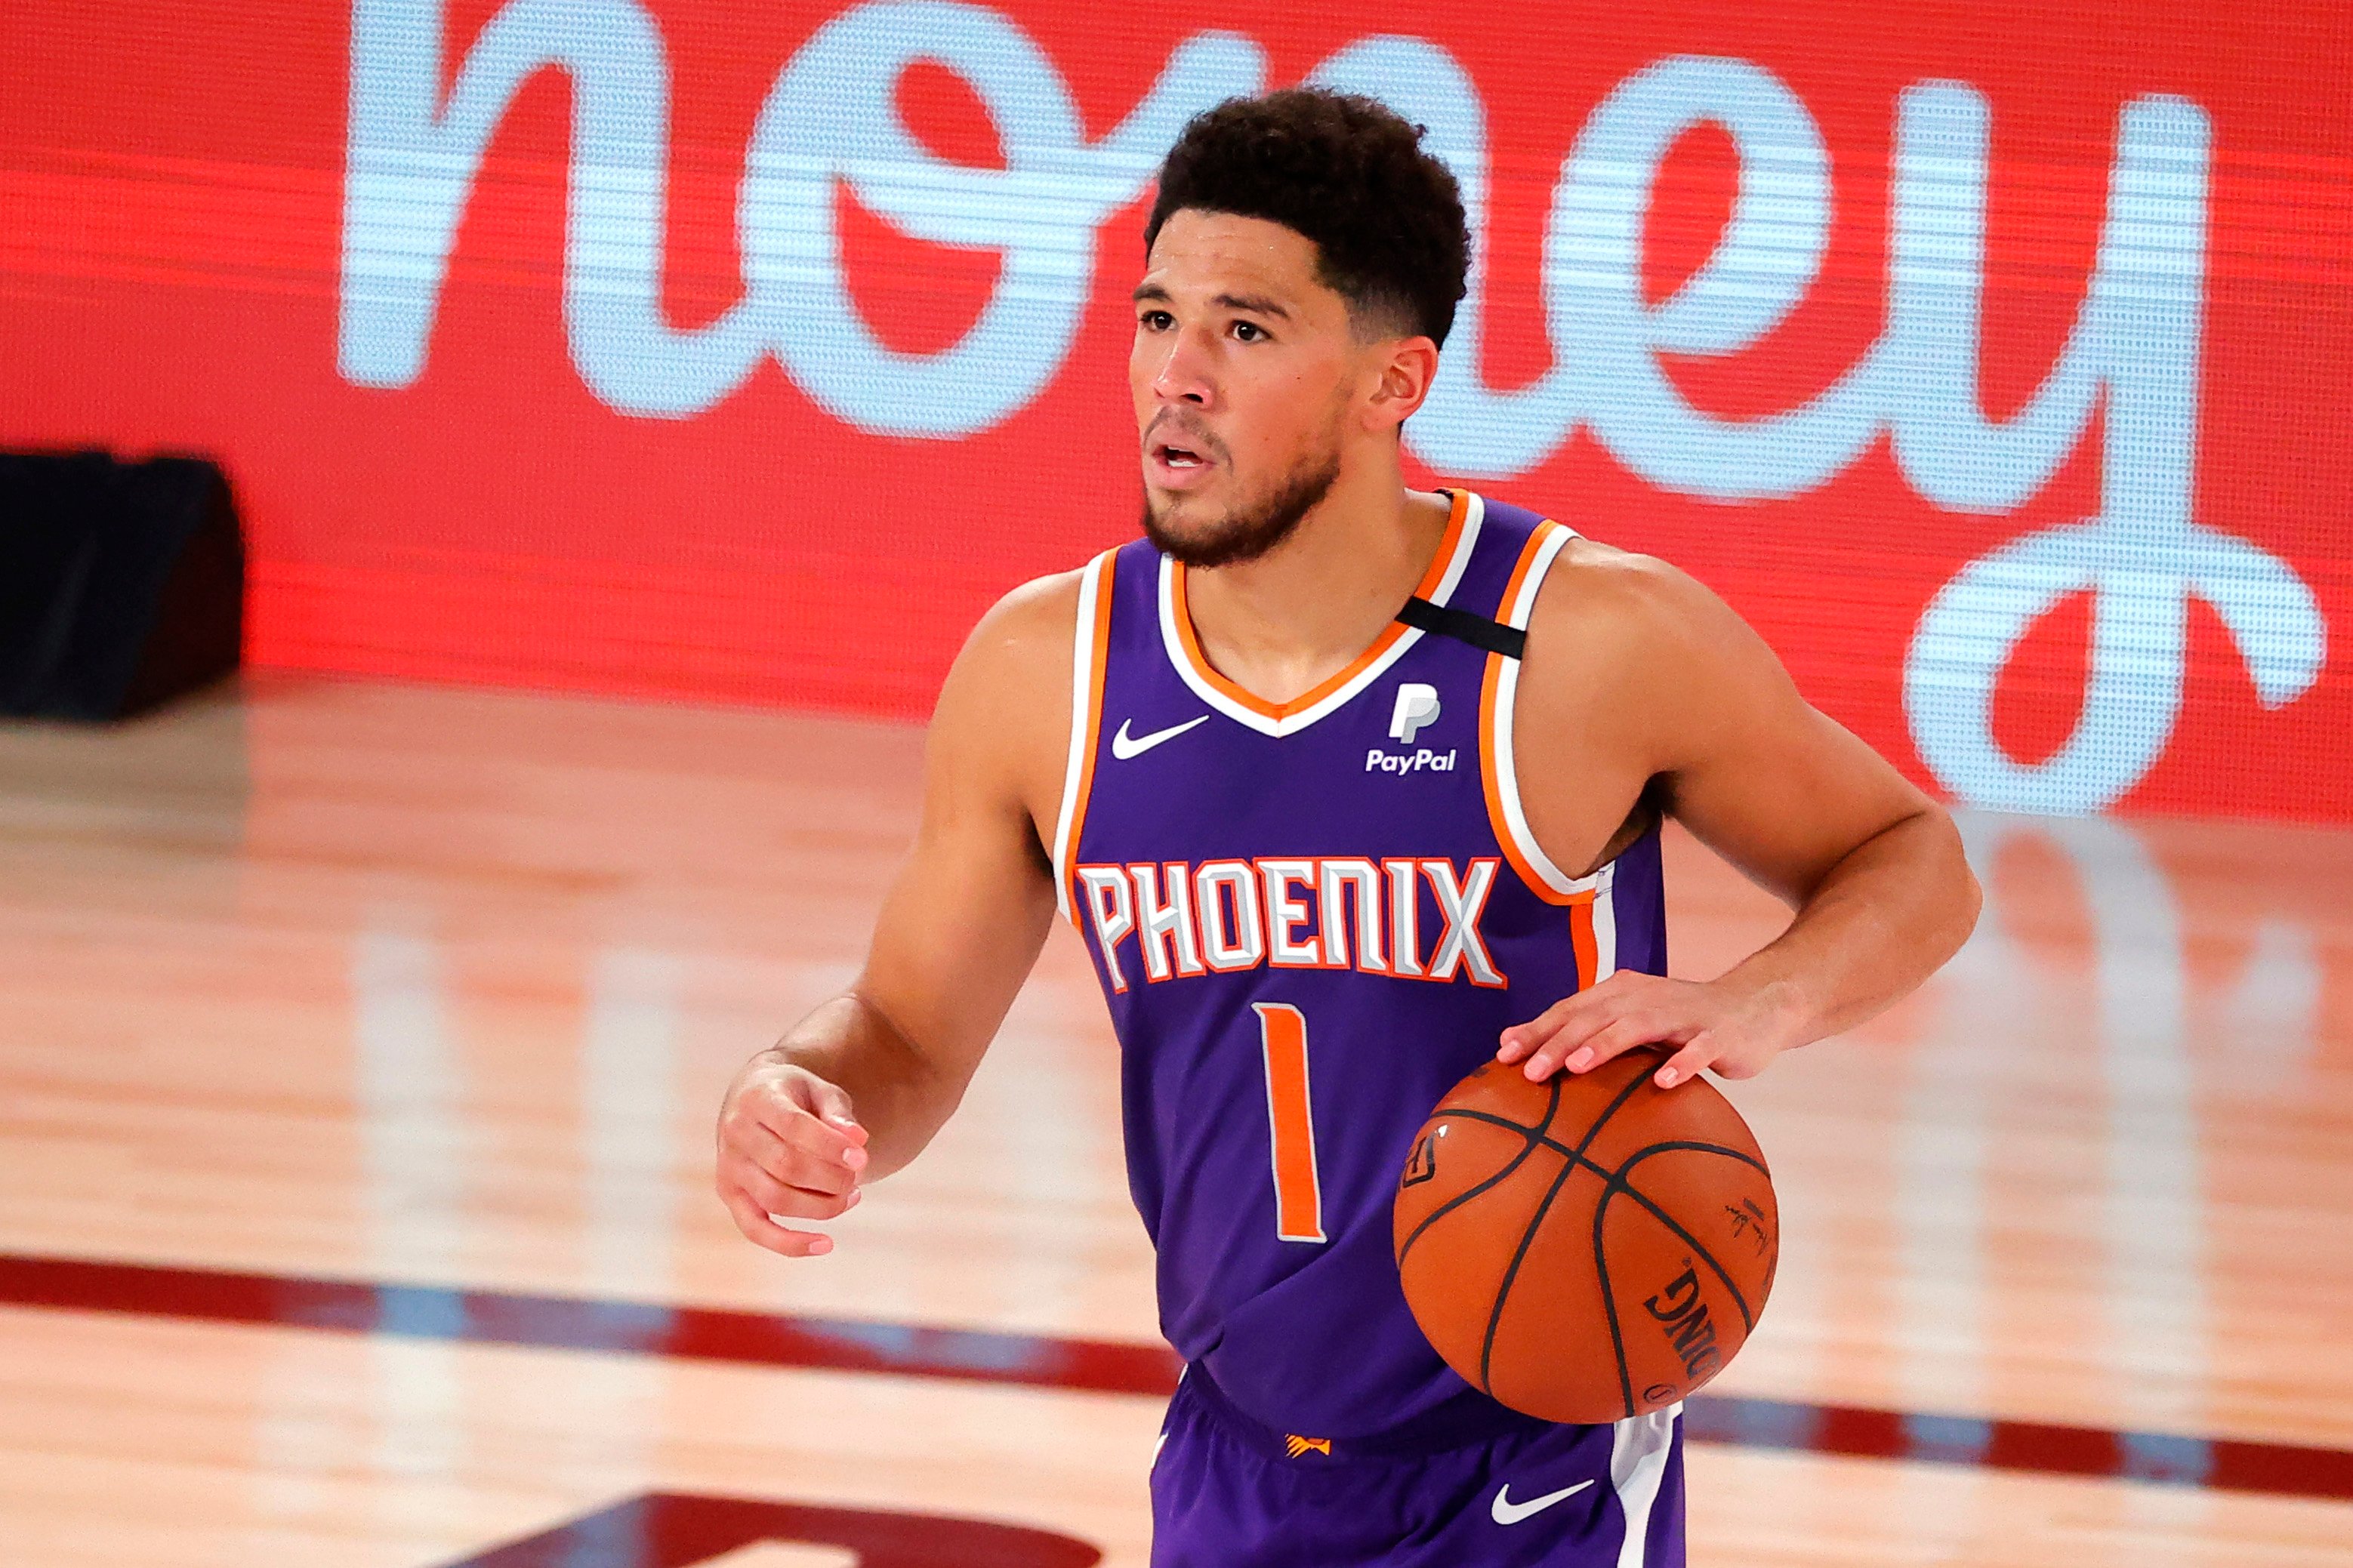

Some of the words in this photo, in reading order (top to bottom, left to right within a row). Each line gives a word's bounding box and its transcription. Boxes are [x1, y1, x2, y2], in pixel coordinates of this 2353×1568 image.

[1365, 748, 1457, 776] PayPal
[1074, 855, 1508, 993] PHOENIX
[1251, 1001, 1328, 1244] 1
[1642, 1268, 1722, 1382] DING
